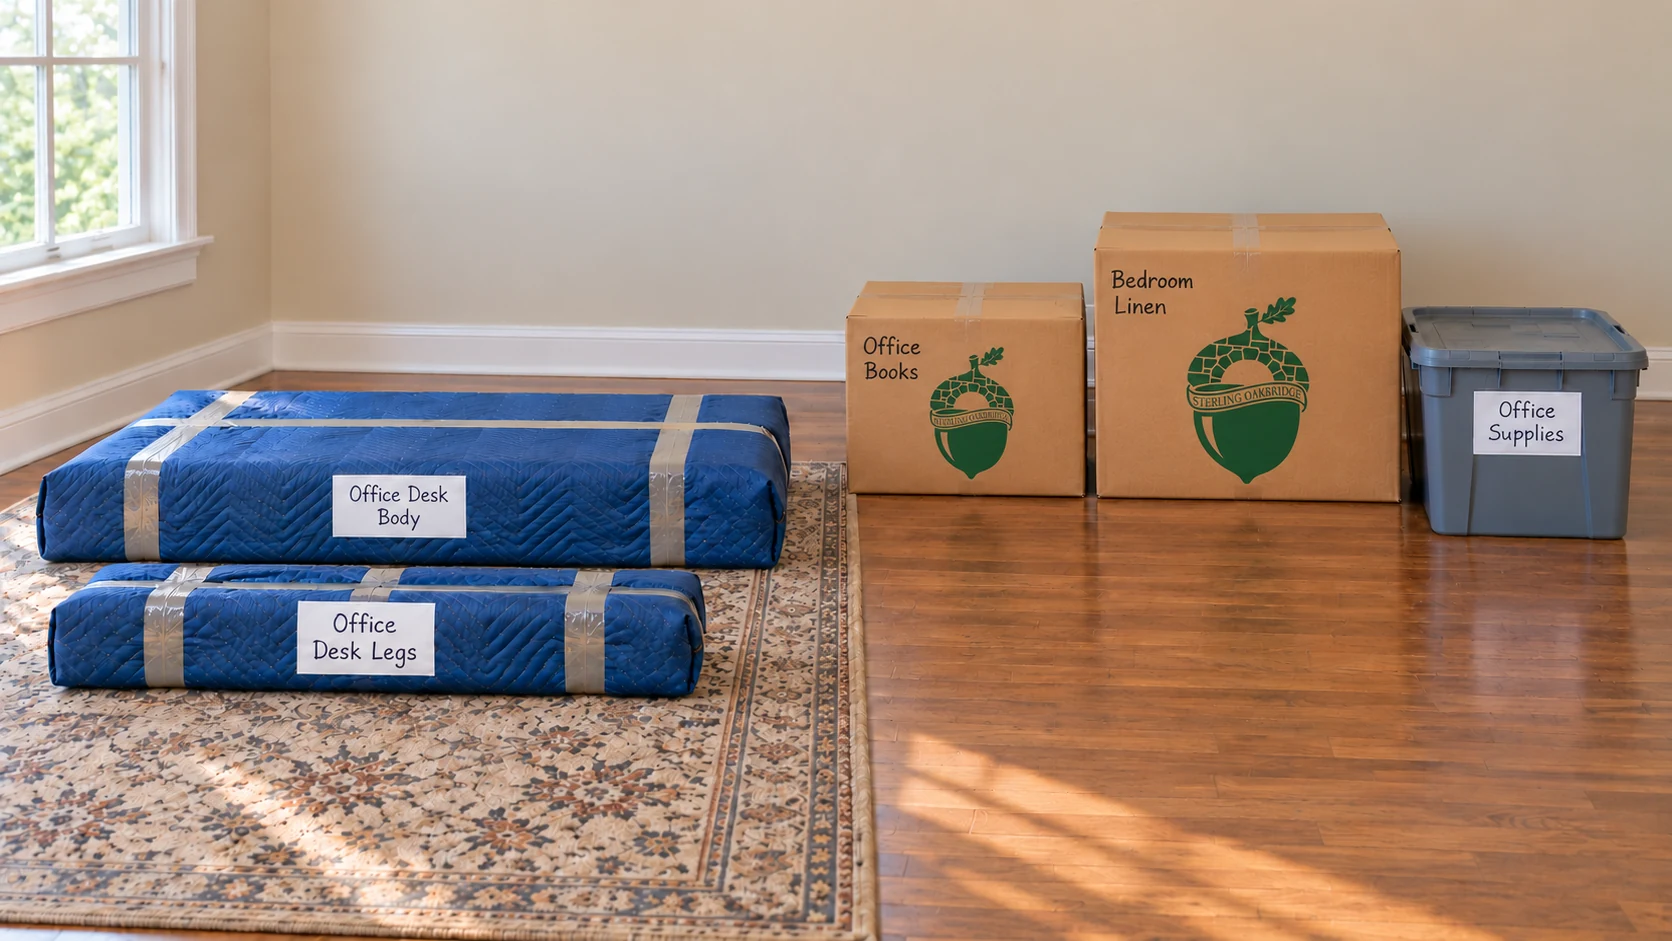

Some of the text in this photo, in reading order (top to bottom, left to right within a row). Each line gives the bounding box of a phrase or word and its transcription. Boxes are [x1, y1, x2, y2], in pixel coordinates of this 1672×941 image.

[1111, 269, 1194, 290] Bedroom
[1114, 295, 1167, 315] Linen
[863, 336, 921, 356] Office
[864, 361, 919, 381] Books
[1192, 385, 1301, 408] STERLING OAKBRIDGE
[1498, 400, 1556, 420] Office
[1488, 424, 1565, 447] Supplies
[349, 484, 449, 503] Office Desk
[377, 508, 421, 531] Body
[333, 612, 397, 634] Office
[312, 640, 418, 668] Desk Legs
